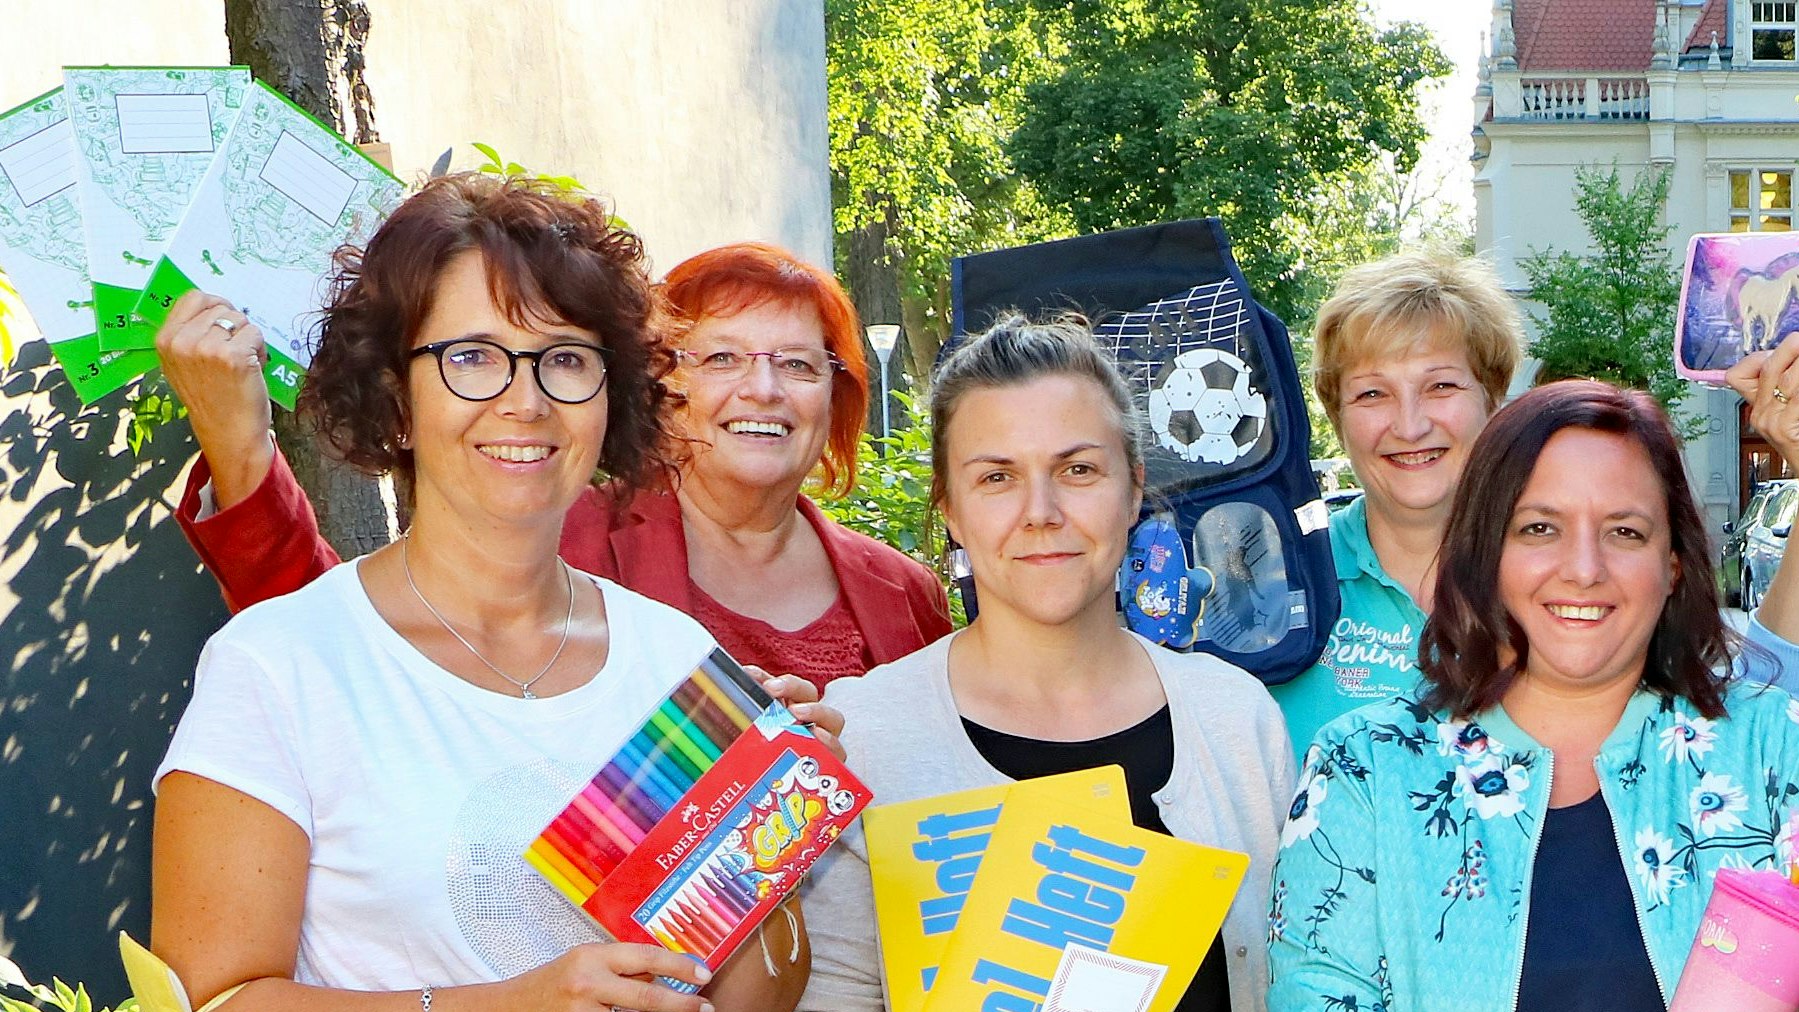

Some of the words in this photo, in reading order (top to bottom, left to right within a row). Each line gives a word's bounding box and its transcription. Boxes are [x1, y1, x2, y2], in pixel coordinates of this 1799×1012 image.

[160, 295, 173, 308] 3
[116, 315, 126, 328] 3
[78, 375, 91, 383] Nr.
[87, 363, 99, 377] 3
[271, 364, 299, 387] A5
[1336, 618, 1413, 643] Original
[655, 781, 746, 870] FABER-CASTELL
[753, 791, 807, 859] GRIP
[1000, 824, 1147, 952] Heft
[638, 909, 651, 922] 20
